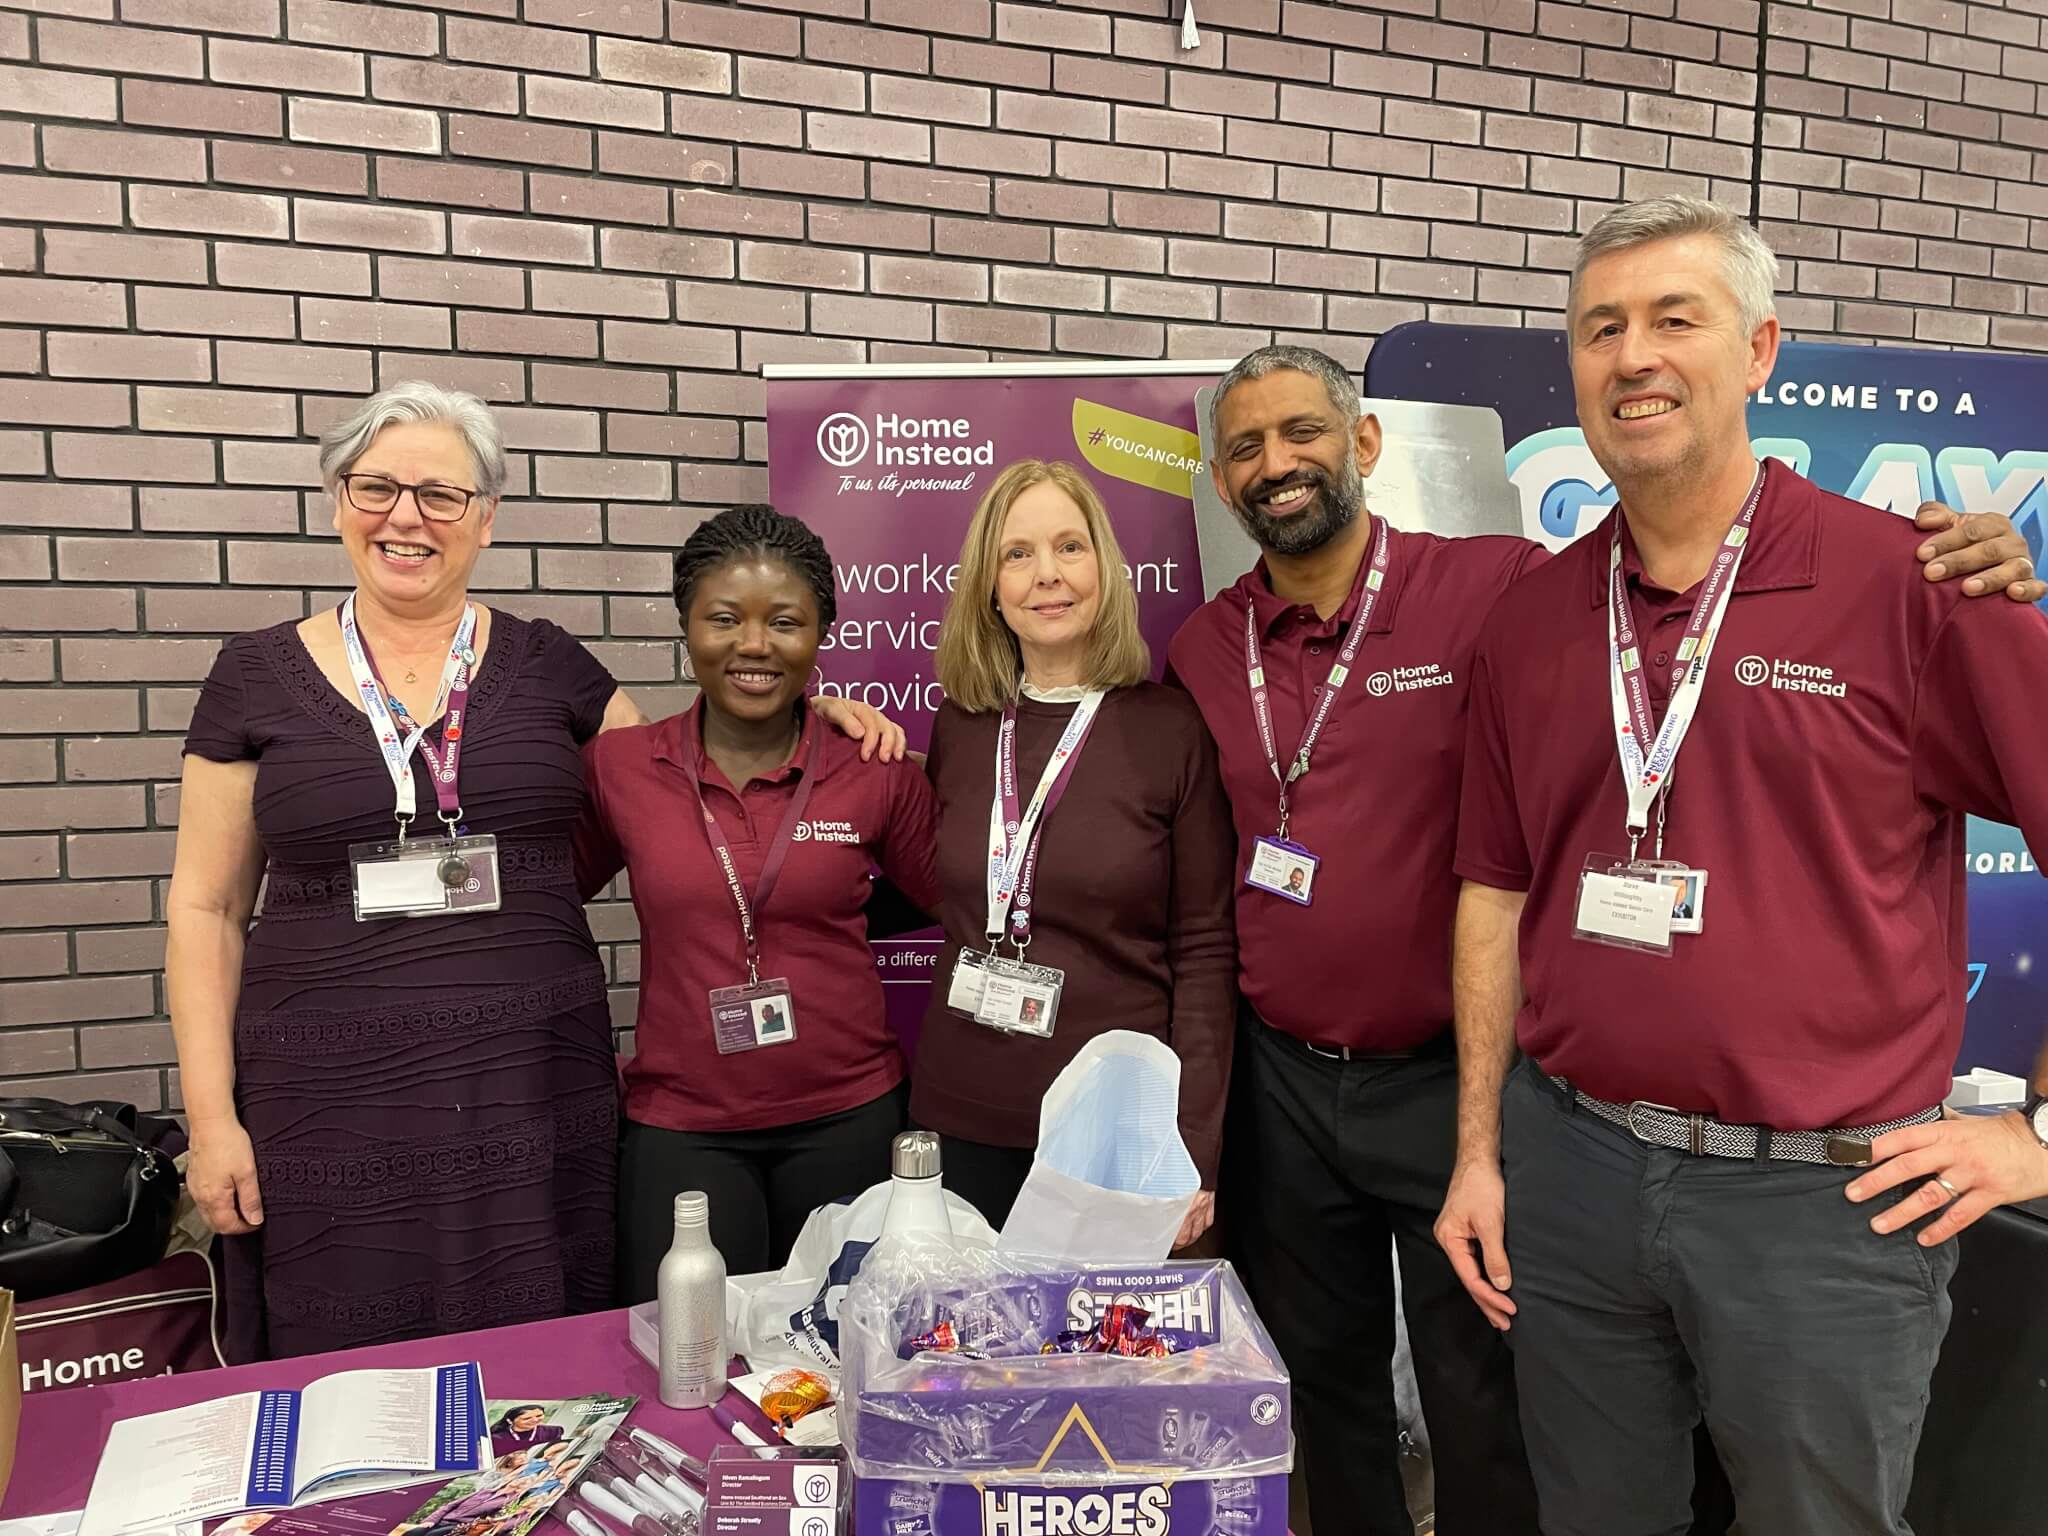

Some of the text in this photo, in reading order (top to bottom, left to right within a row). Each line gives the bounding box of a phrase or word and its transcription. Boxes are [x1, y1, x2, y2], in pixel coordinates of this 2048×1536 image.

[1746, 382, 1977, 415] LCOME TO A
[876, 413, 970, 438] Home
[876, 440, 994, 465] Instead
[837, 475, 857, 496] To
[878, 471, 899, 491] it's
[896, 471, 976, 498] personal
[837, 553, 961, 593] worke
[1692, 563, 1727, 632] Home Instead
[818, 611, 941, 650] servic
[1348, 594, 1374, 650] Home Instead
[1616, 603, 1629, 632] Home
[1392, 663, 1440, 680] Home
[1394, 671, 1453, 692] Instead
[1773, 658, 1833, 679] Home
[1772, 674, 1846, 697] Instead
[1305, 690, 1335, 748] Home Instead
[1629, 676, 1651, 743] Home Instead
[1256, 701, 1274, 758] Home Instead
[1649, 713, 1678, 771] NETWORKING
[443, 742, 457, 769] Home
[1003, 731, 1014, 797] Home Instead
[1656, 748, 1671, 773] ESSEX
[812, 820, 852, 831] Home
[814, 830, 860, 844] Instead
[1021, 859, 1033, 893] Home
[1966, 852, 2038, 874] ORL
[716, 846, 748, 915] Home Instead
[877, 951, 938, 966] a differe
[1095, 1274, 1184, 1286] SHARE GOOD TIMES
[21, 1347, 145, 1392] Home
[984, 1485, 1171, 1536] HEROES
